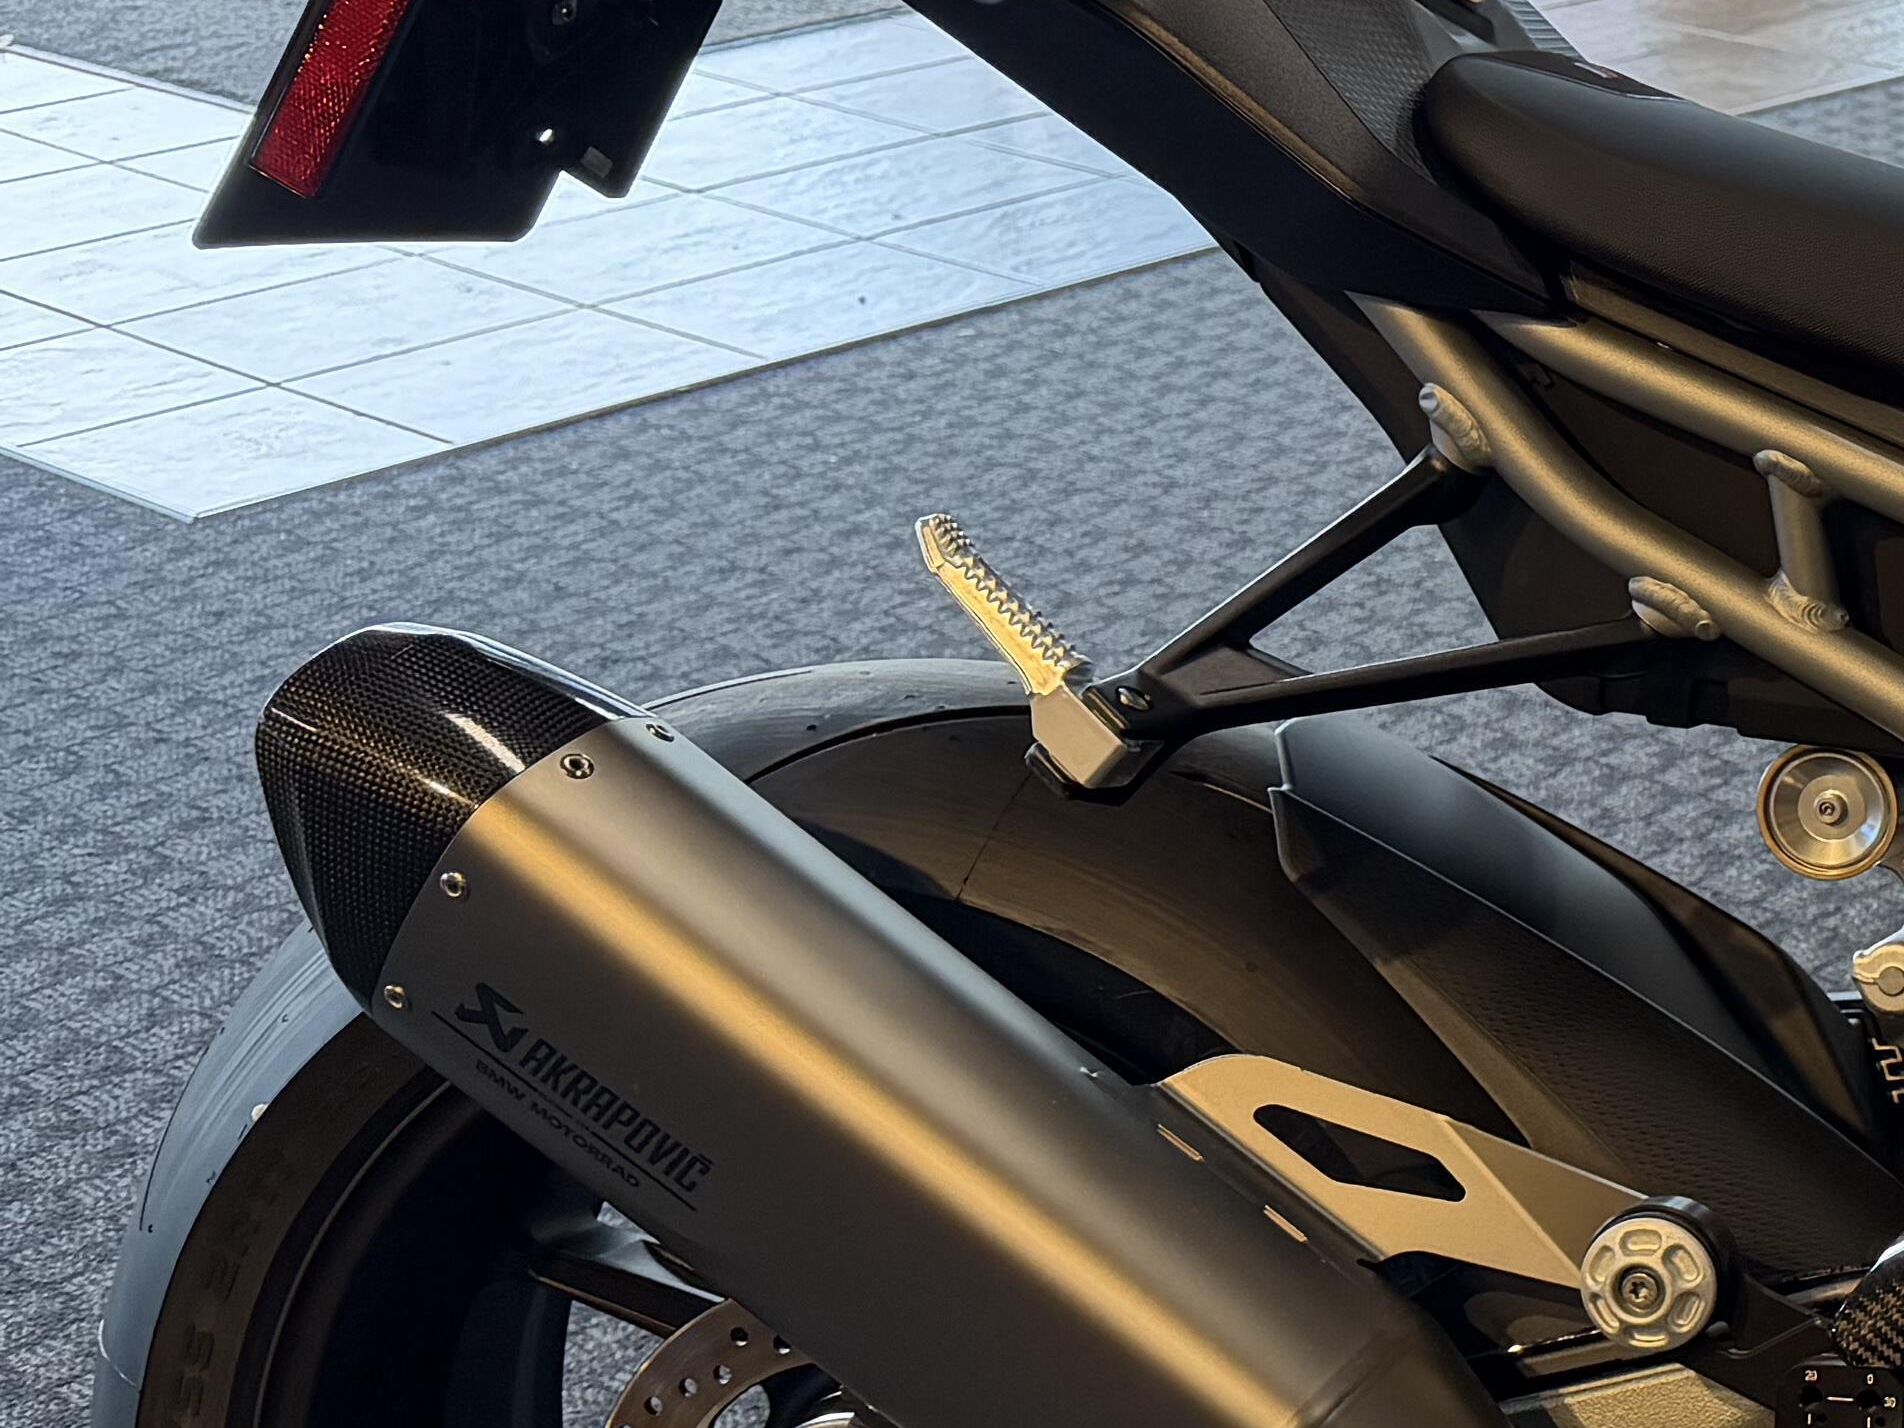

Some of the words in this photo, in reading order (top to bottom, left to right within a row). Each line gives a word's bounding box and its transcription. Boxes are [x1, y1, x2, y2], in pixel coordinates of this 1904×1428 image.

[474, 1058, 527, 1102] BMW
[530, 1101, 641, 1189] MOTORRAD
[519, 1037, 714, 1193] AKRAPOVIČ
